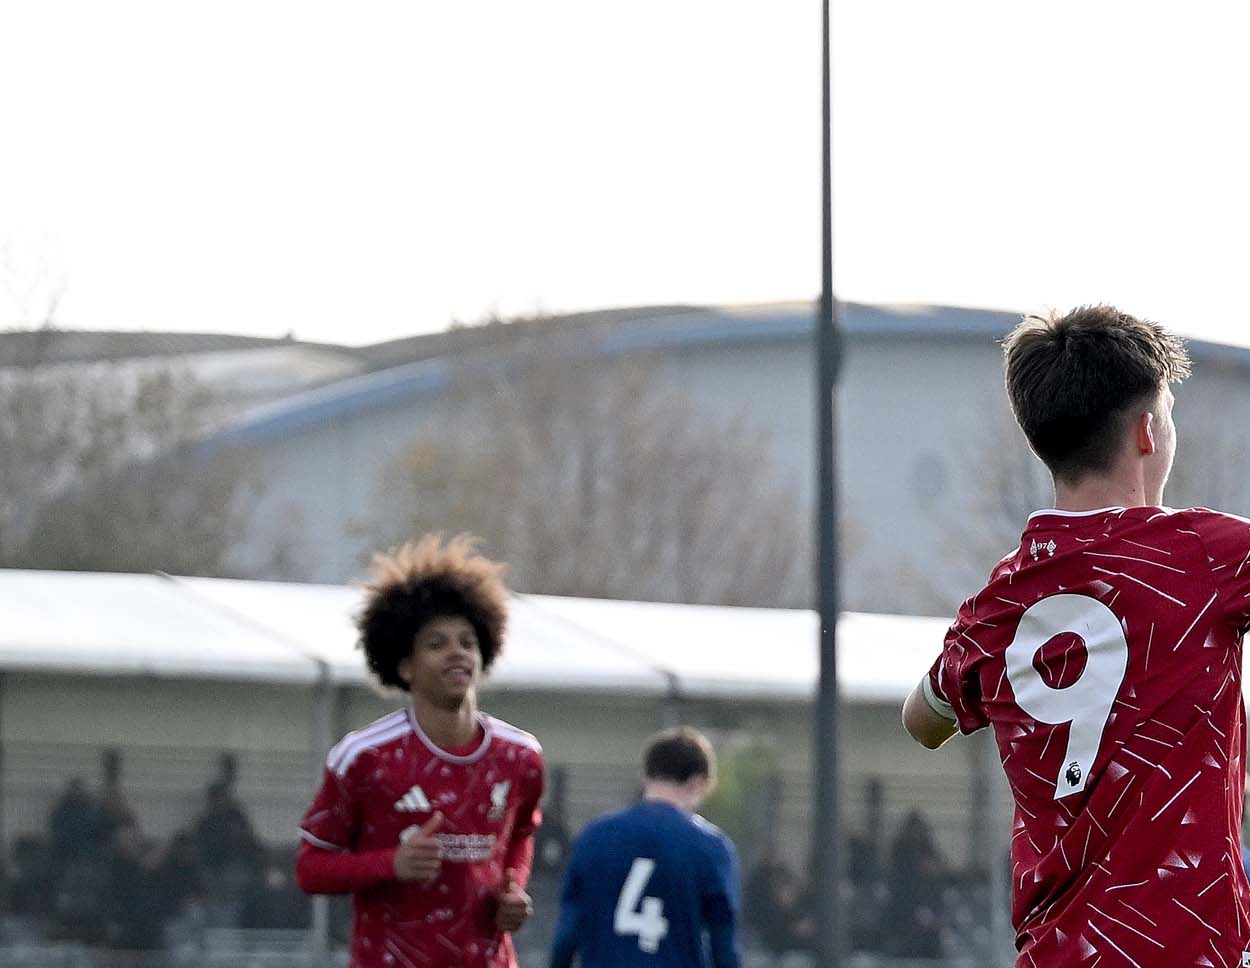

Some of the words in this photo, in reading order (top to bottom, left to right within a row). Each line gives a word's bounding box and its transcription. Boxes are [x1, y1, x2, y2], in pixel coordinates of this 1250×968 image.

[1037, 542, 1048, 550] 97
[1005, 593, 1128, 800] 9
[613, 857, 669, 953] 4
